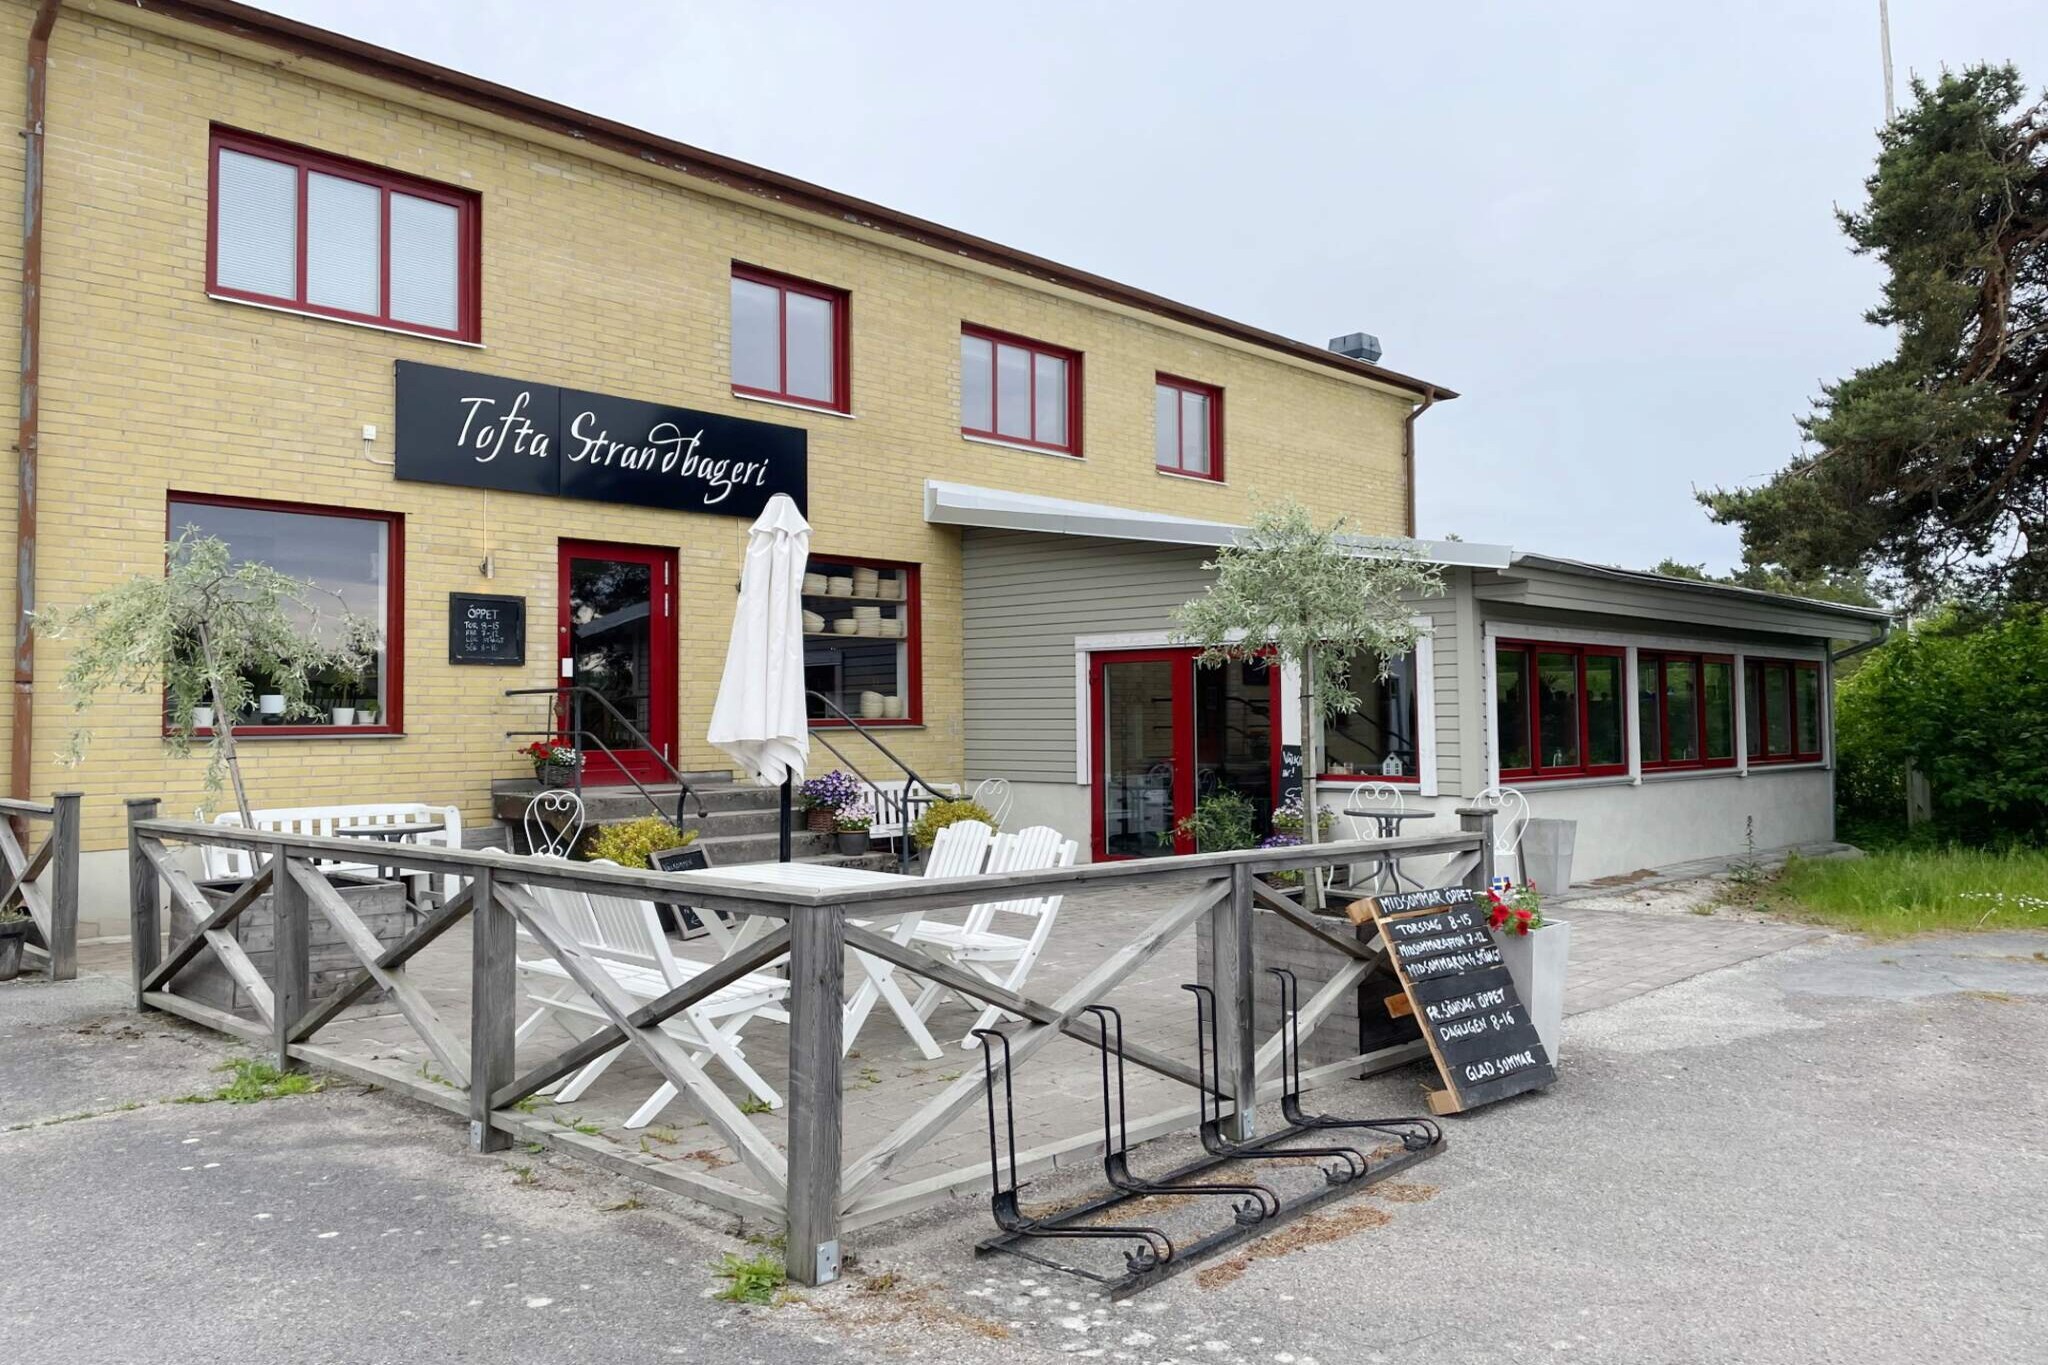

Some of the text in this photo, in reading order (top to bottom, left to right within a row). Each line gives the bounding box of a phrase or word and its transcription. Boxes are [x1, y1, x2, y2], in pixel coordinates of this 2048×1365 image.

[457, 391, 769, 504] Tofta Strandbageri
[467, 604, 500, 620] ÖPPET
[1380, 887, 1474, 913] MIDSOMMAR ÖPPET
[1395, 913, 1472, 935] TORSDAG 8-15
[1477, 988, 1505, 1008] ÖPPET
[1490, 1010, 1515, 1031] 8-16
[1465, 1050, 1536, 1081] GLAD SOMMAR
